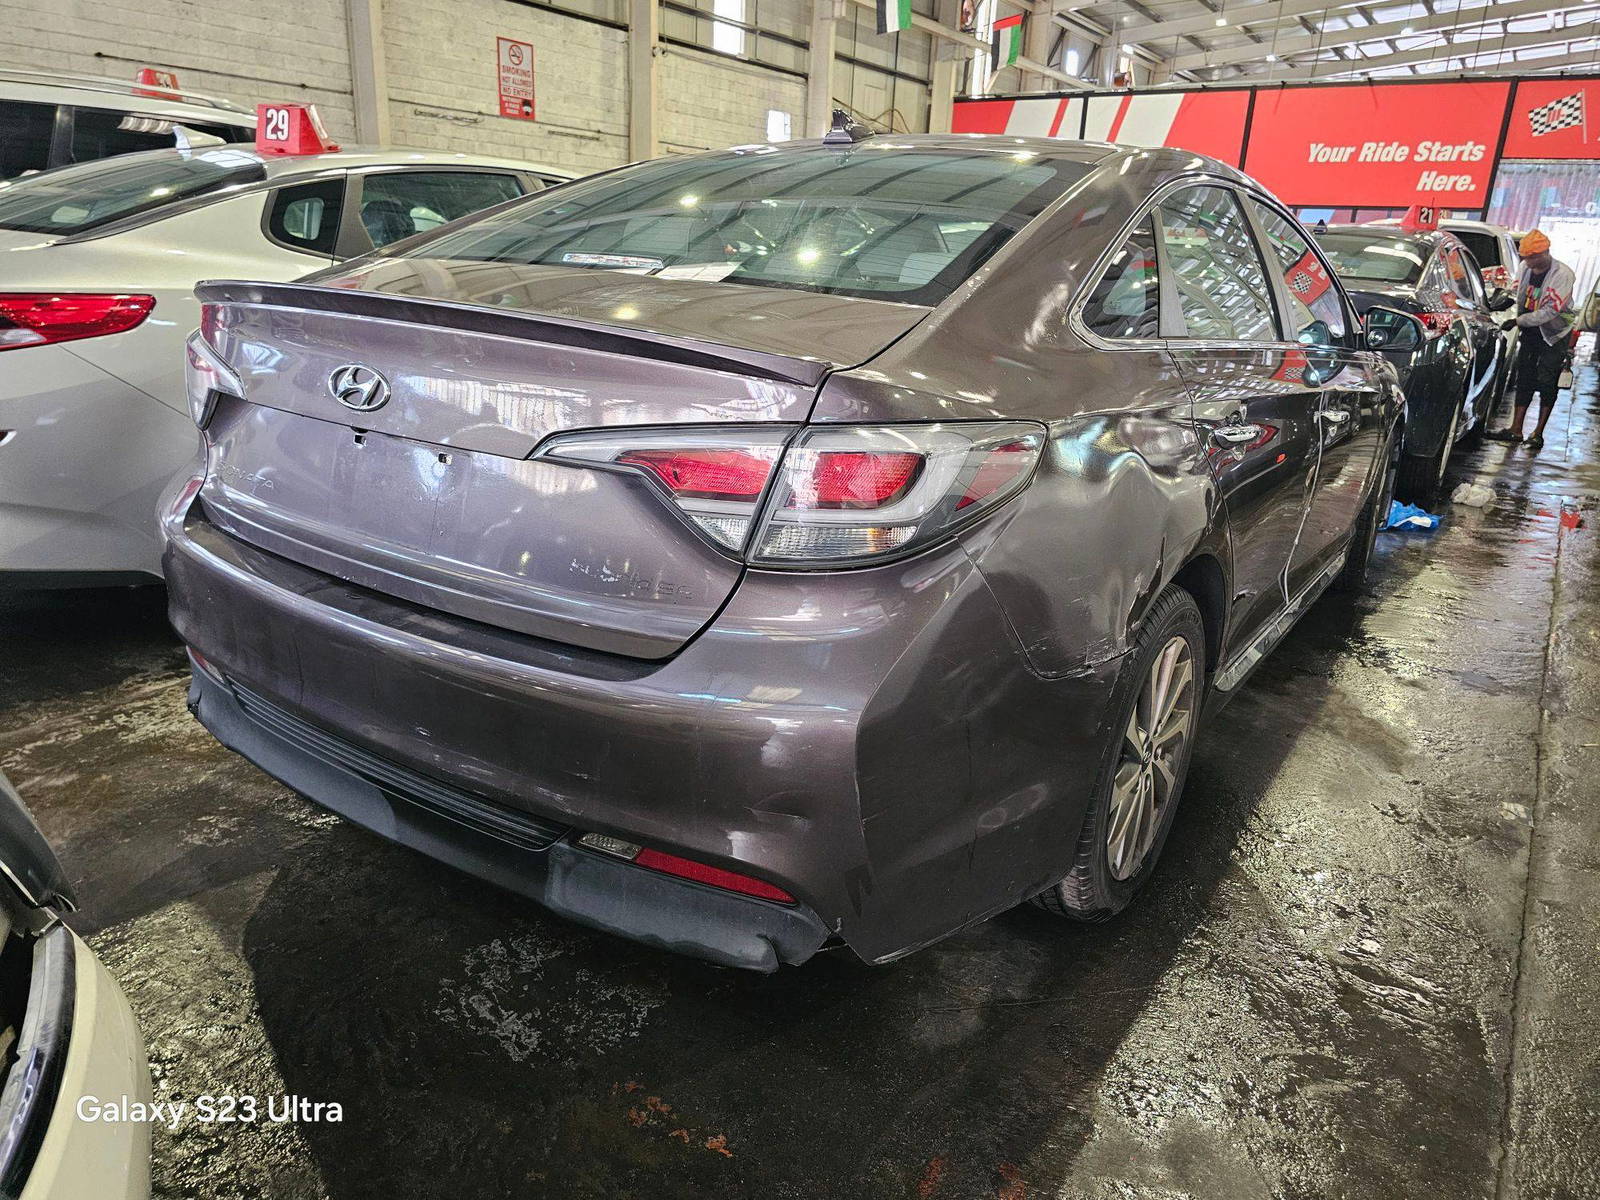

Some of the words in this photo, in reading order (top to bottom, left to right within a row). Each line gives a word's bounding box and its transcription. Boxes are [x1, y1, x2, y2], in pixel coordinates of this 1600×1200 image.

[502, 65, 531, 78] SMOKING
[513, 88, 531, 98] ENTRY
[266, 108, 289, 140] 29
[1308, 143, 1356, 163] Your
[1358, 142, 1409, 162] Ride
[1413, 141, 1486, 162] Starts
[1416, 171, 1476, 191] Here.
[1420, 207, 1433, 224] 21
